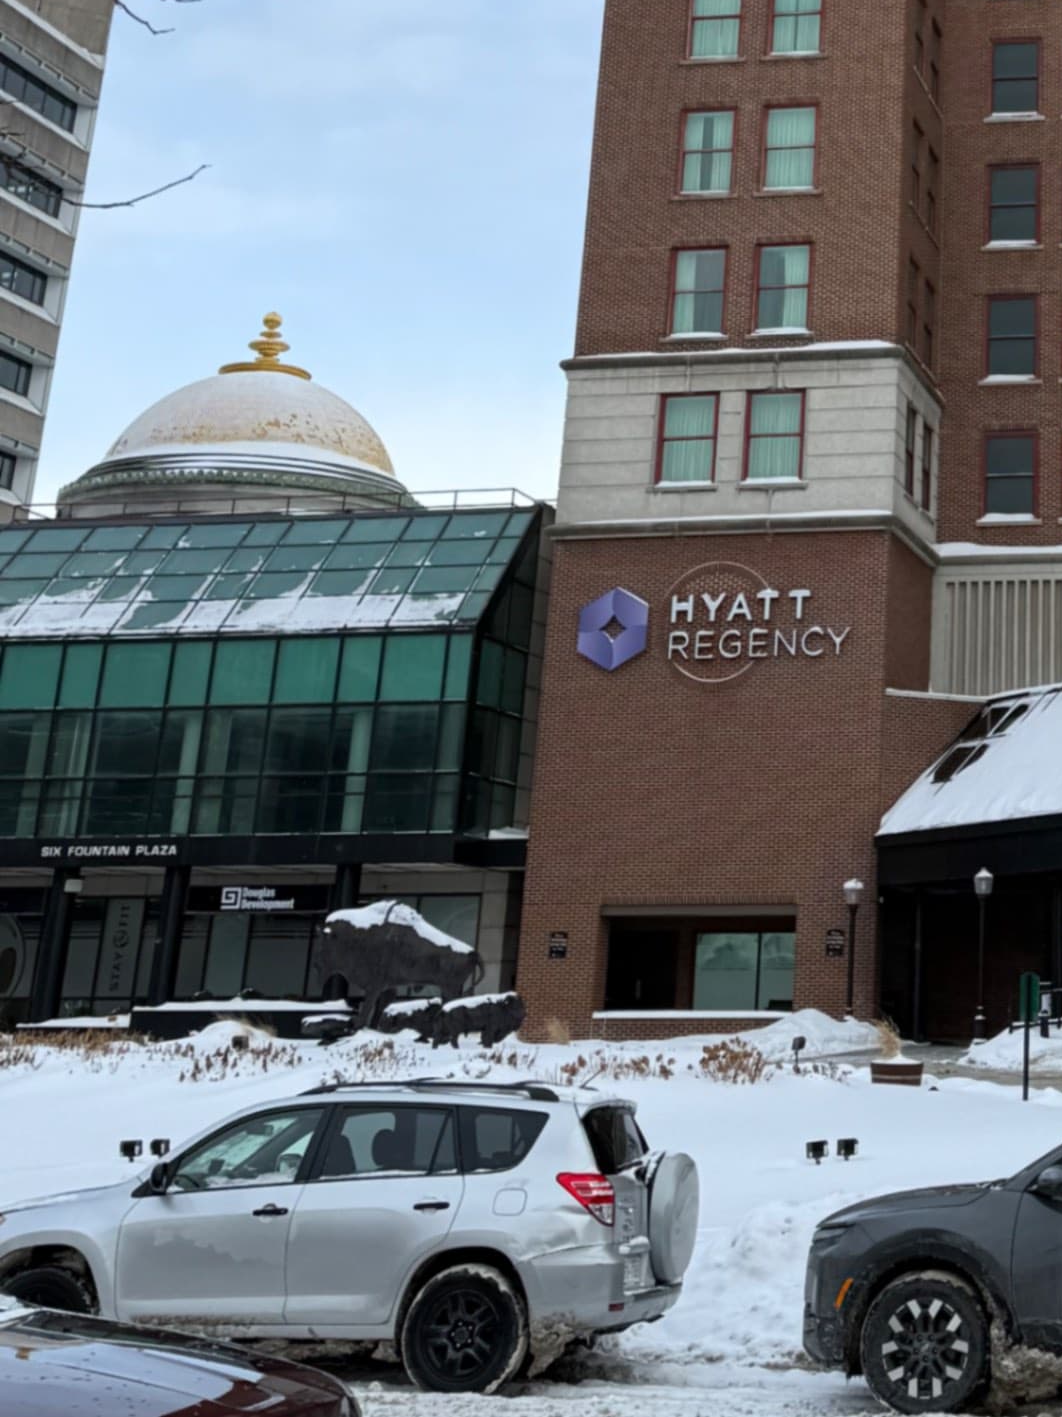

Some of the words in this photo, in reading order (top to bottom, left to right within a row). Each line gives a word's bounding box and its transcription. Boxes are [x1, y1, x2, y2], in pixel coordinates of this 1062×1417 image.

[670, 588, 812, 623] HYATT
[667, 626, 850, 660] REGENCY
[40, 845, 61, 857] SIX
[67, 845, 131, 857] FOUNTAIN
[135, 844, 178, 856] PLAZA
[242, 886, 276, 899] Douglas
[241, 898, 295, 911] Development
